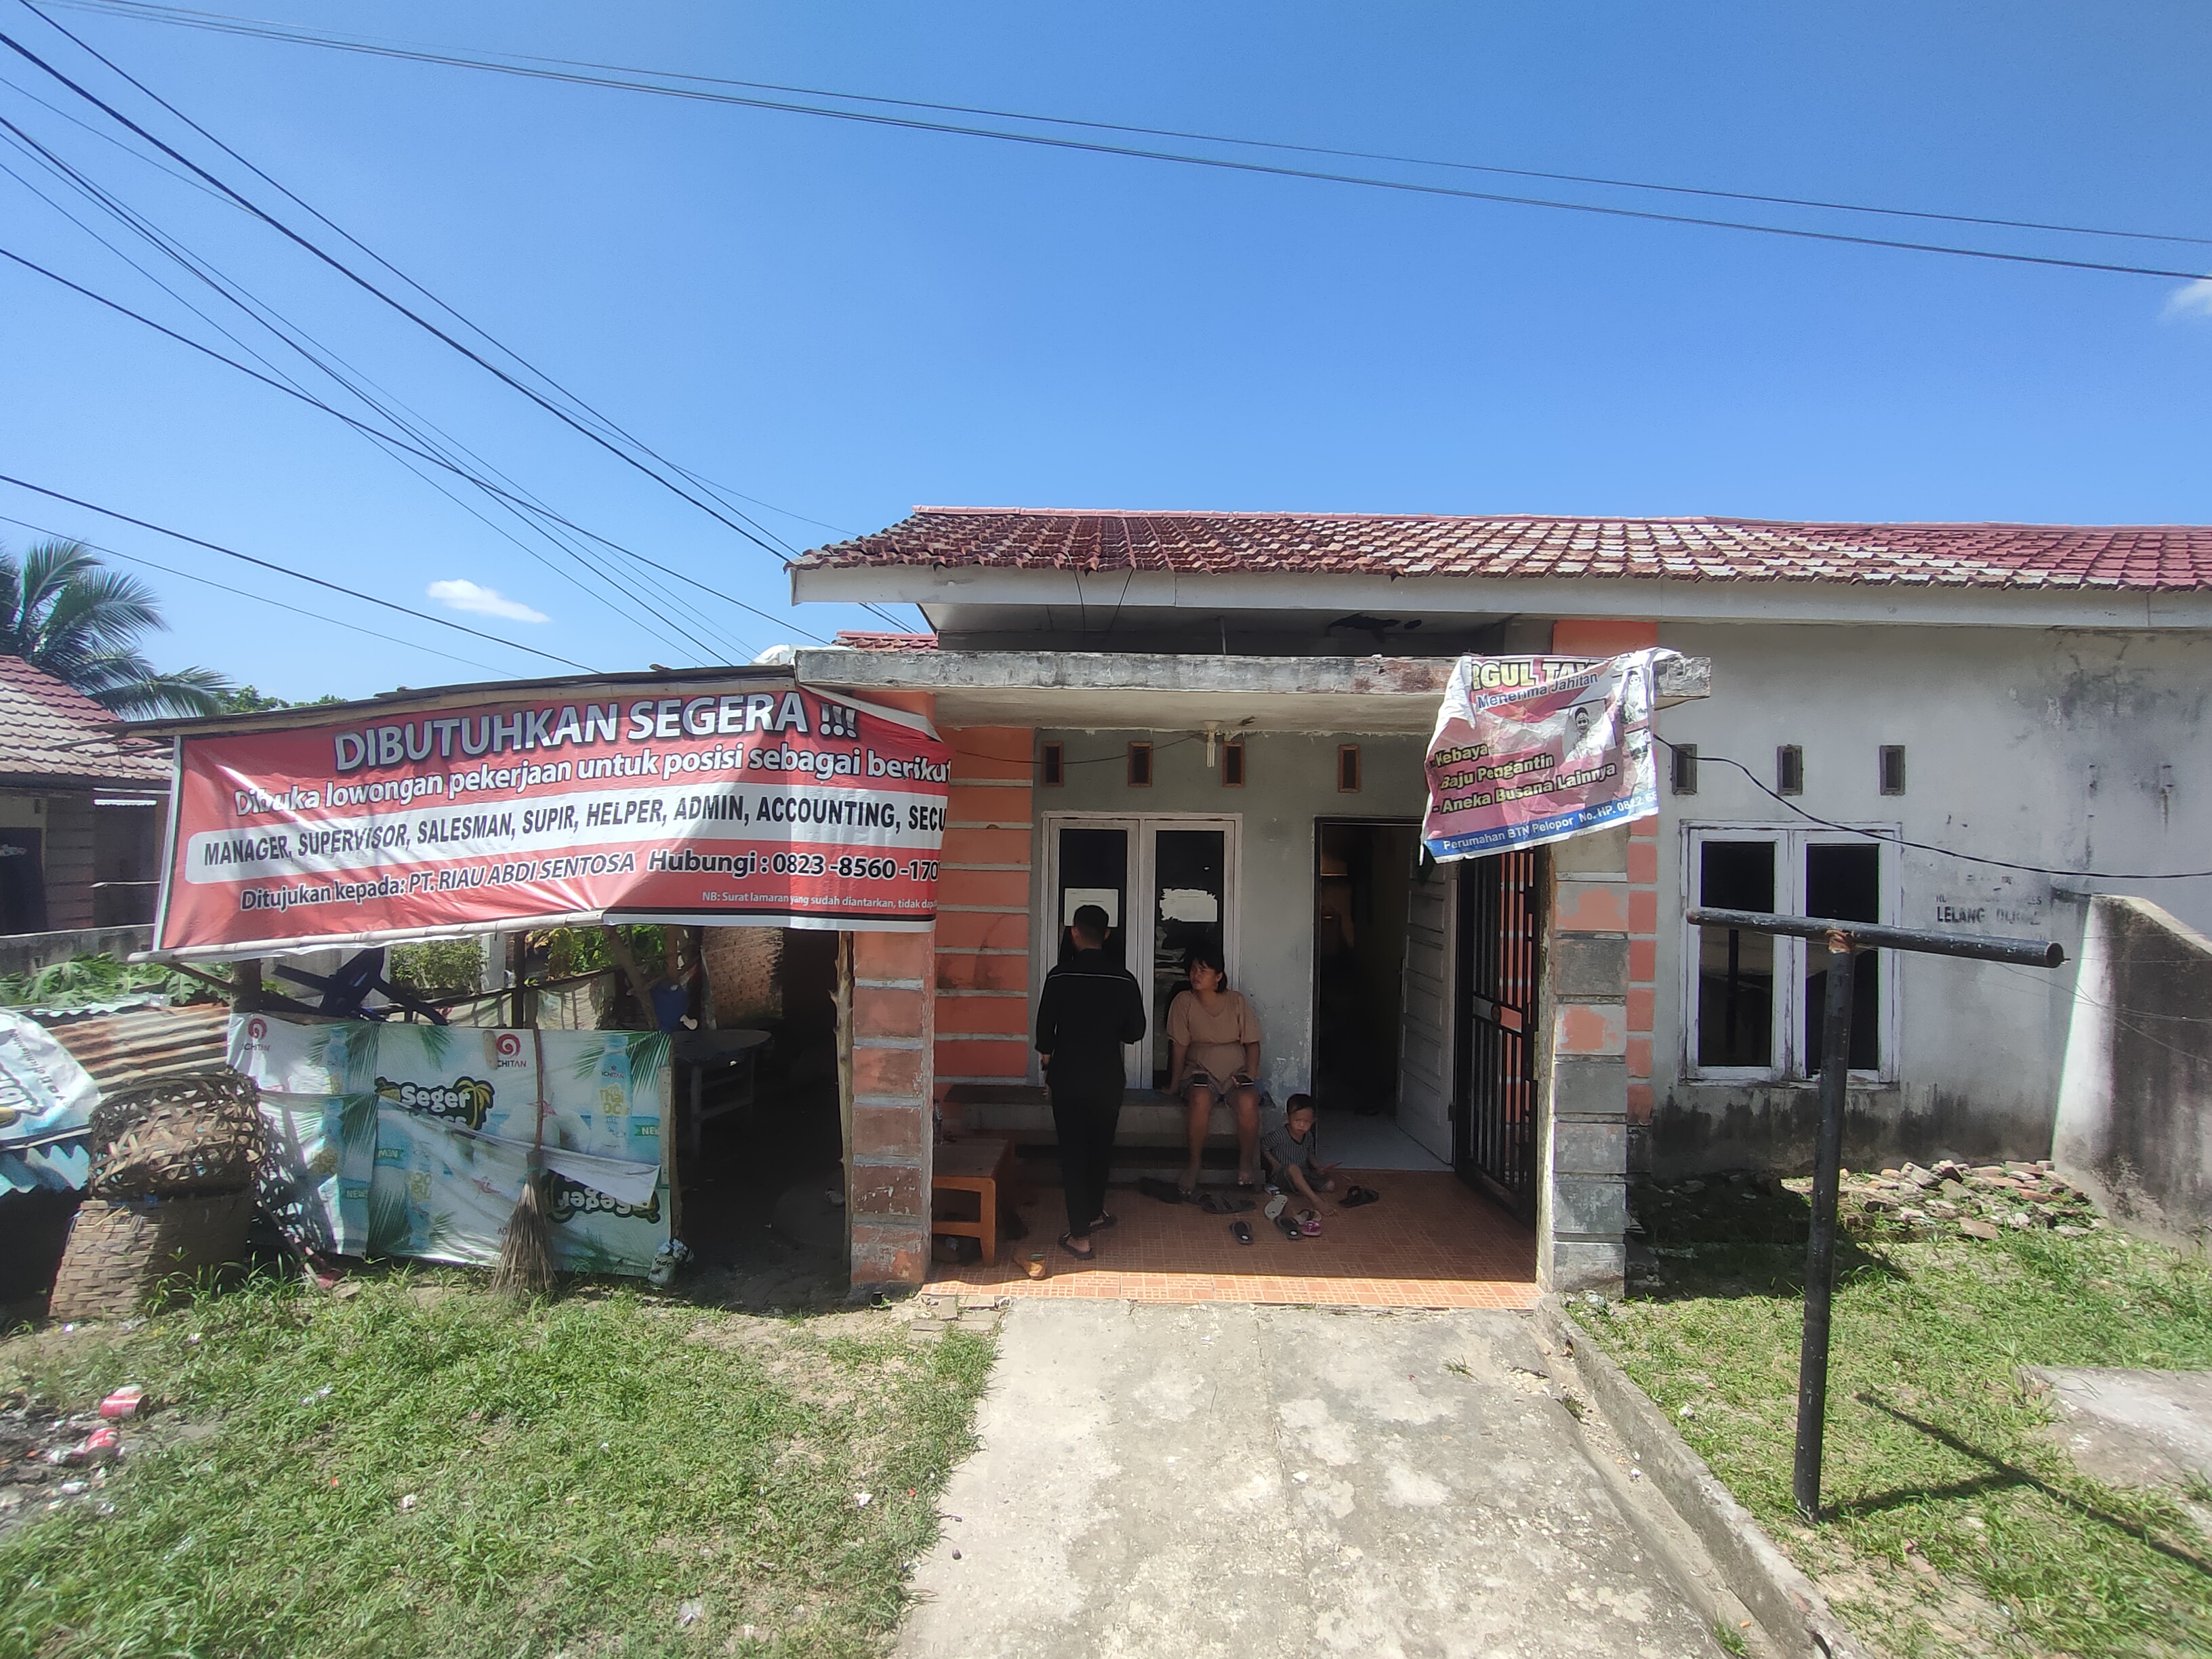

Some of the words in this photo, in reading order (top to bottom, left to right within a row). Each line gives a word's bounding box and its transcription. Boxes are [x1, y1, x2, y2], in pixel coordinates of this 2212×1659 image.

[1477, 685, 1548, 710] Menerima
[1551, 673, 1598, 693] Jahitan
[335, 703, 618, 771] DIBUTUHKAN
[628, 691, 808, 740] SEGERA
[1435, 744, 1489, 767] Kebaya
[1441, 773, 1474, 790] Baju
[1477, 754, 1554, 781] Pengantin
[235, 785, 320, 816] Dibuka
[326, 774, 443, 805] lowongan
[449, 760, 571, 800] pekerjaan
[577, 748, 659, 779] untuk
[663, 745, 742, 780] posisi
[749, 743, 860, 781] sebagai
[1441, 793, 1492, 814] Aneka
[1495, 782, 1553, 803] Busana
[1558, 764, 1616, 790] Lainnya
[204, 835, 293, 866] MANAGER,
[298, 823, 411, 857] SUPERVISOR,
[417, 812, 516, 842] SALESMAN,
[523, 804, 579, 834] SUPIR,
[586, 798, 668, 827] HELPER,
[674, 795, 749, 827] ADMIN,
[756, 796, 901, 834] ACCOUNTING,
[1443, 832, 1505, 850] Perumahan
[1508, 827, 1530, 839] BTN
[1532, 817, 1574, 835] Pelopor
[1578, 812, 1597, 823] No.
[1597, 804, 1616, 817] HP.
[241, 882, 331, 912] Ditujukan
[335, 876, 405, 905] kepada:
[409, 872, 434, 893] PT.
[438, 867, 484, 890] RIAU
[487, 862, 535, 884] ABDI
[539, 853, 634, 880] SENTOSA
[899, 859, 940, 881] -170
[702, 891, 720, 902] NB:
[722, 891, 748, 902] Surat
[750, 893, 789, 903] lamaran
[790, 895, 808, 906] yang
[811, 895, 840, 906] sudah
[842, 896, 897, 909] diantarkan,
[898, 898, 920, 909] tidak
[497, 1060, 527, 1068] CHITAN
[401, 1085, 471, 1113] Seger
